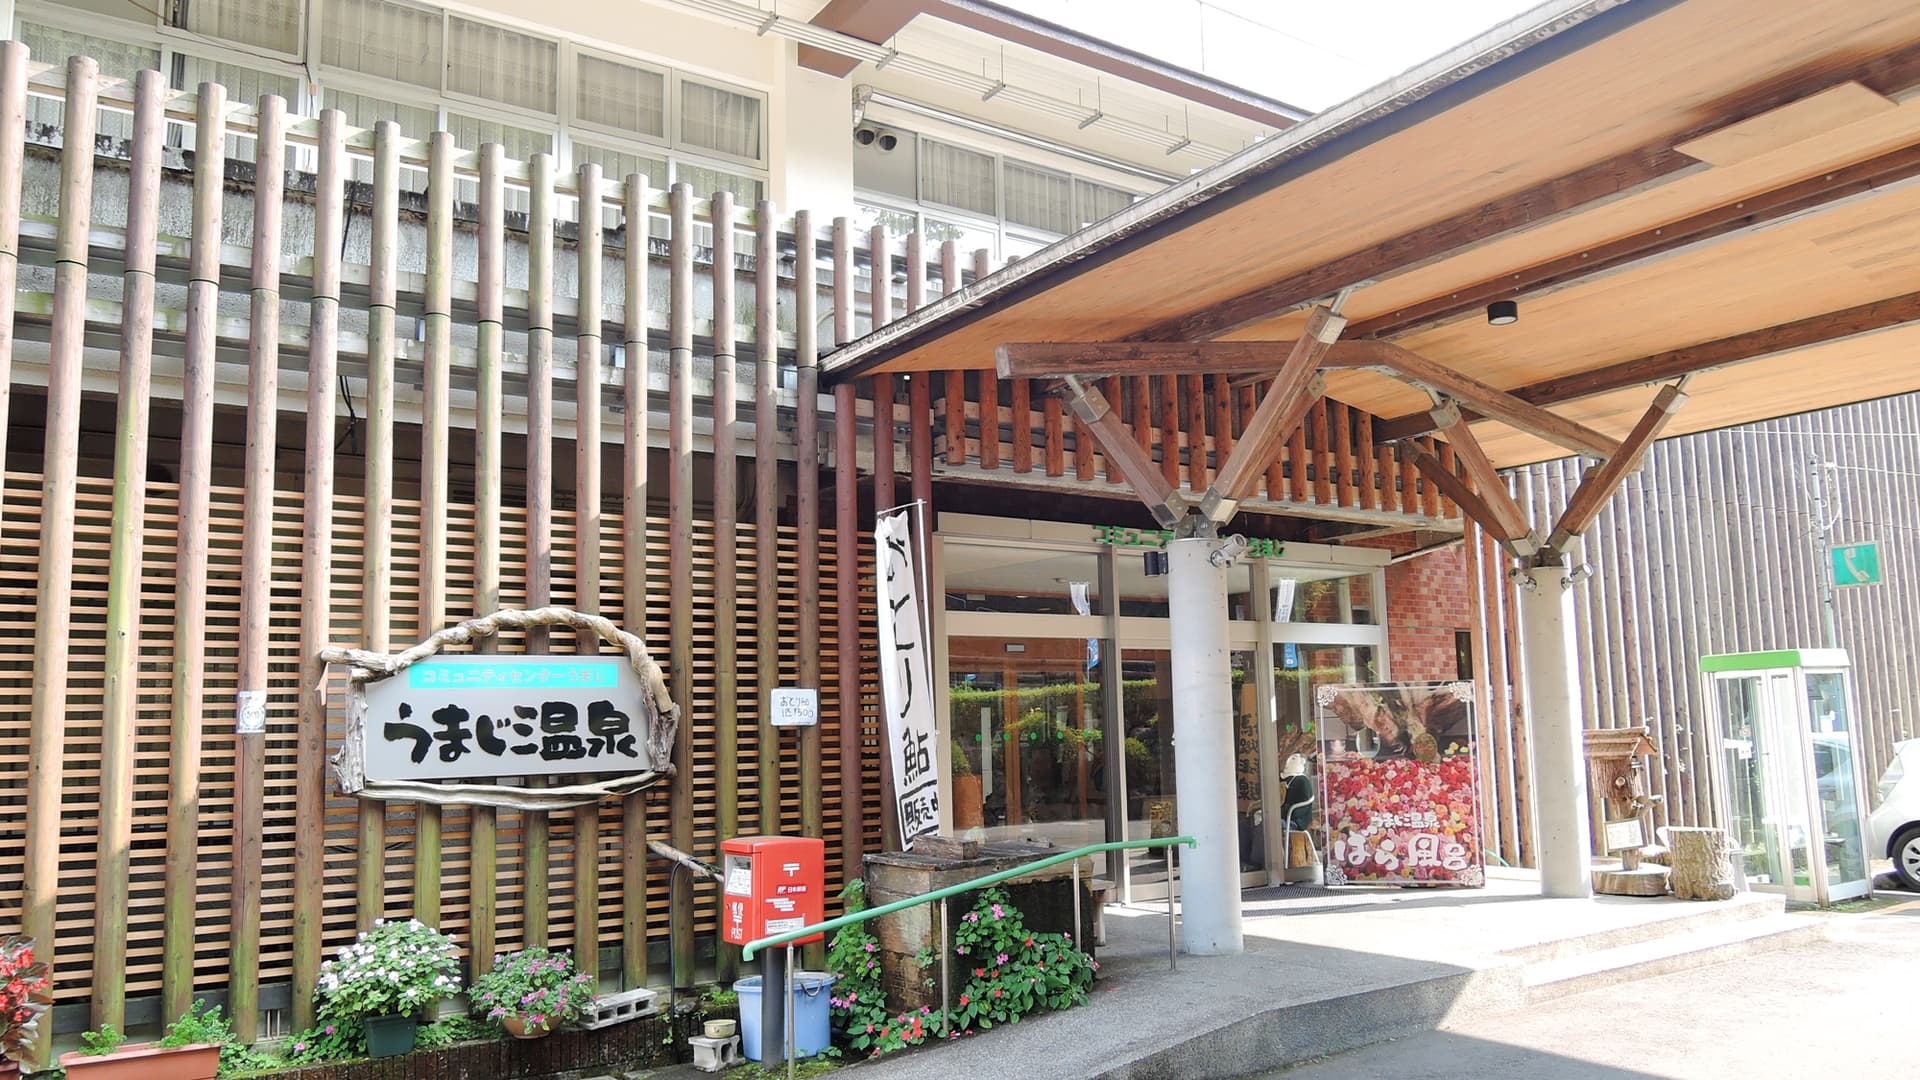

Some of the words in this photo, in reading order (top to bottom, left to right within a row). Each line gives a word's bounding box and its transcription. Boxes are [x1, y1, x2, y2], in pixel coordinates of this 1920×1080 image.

[384, 700, 638, 764] うまじ温泉
